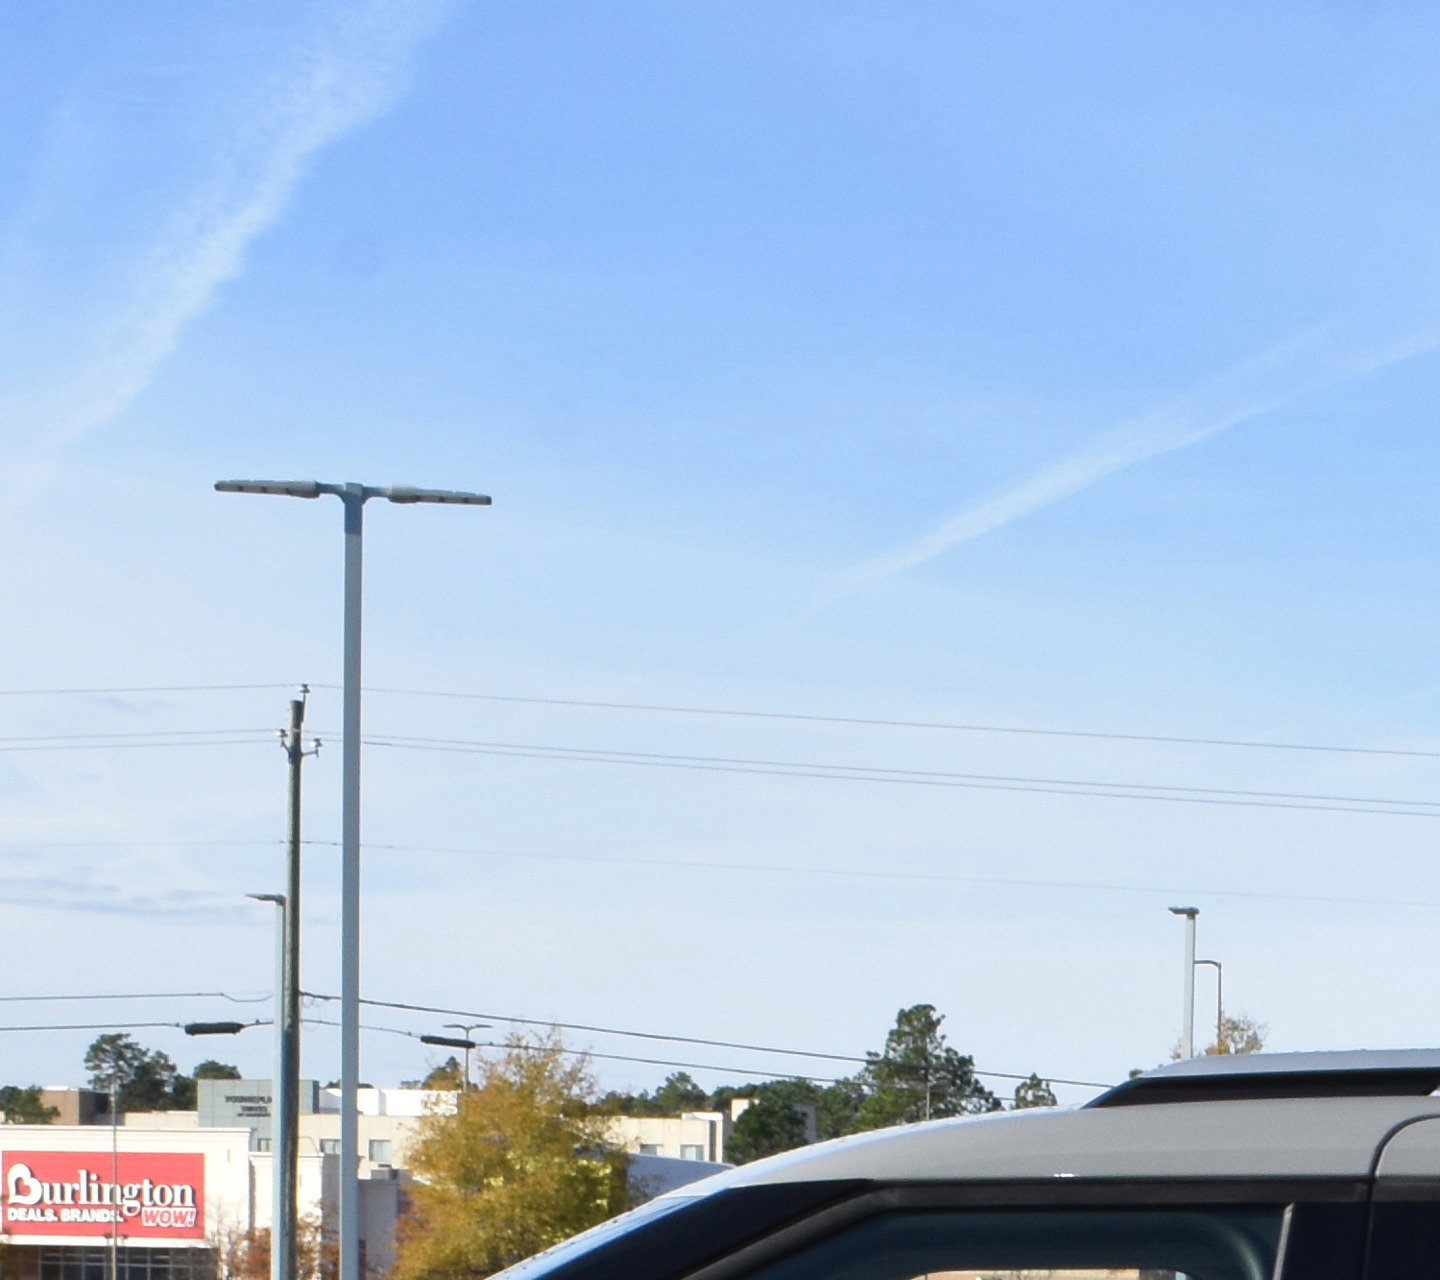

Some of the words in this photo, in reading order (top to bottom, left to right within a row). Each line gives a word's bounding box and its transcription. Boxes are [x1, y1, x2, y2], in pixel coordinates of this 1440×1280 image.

[7, 1163, 195, 1217] Burlington
[7, 1207, 58, 1222] DEALS.
[142, 1207, 197, 1227] WOW!
